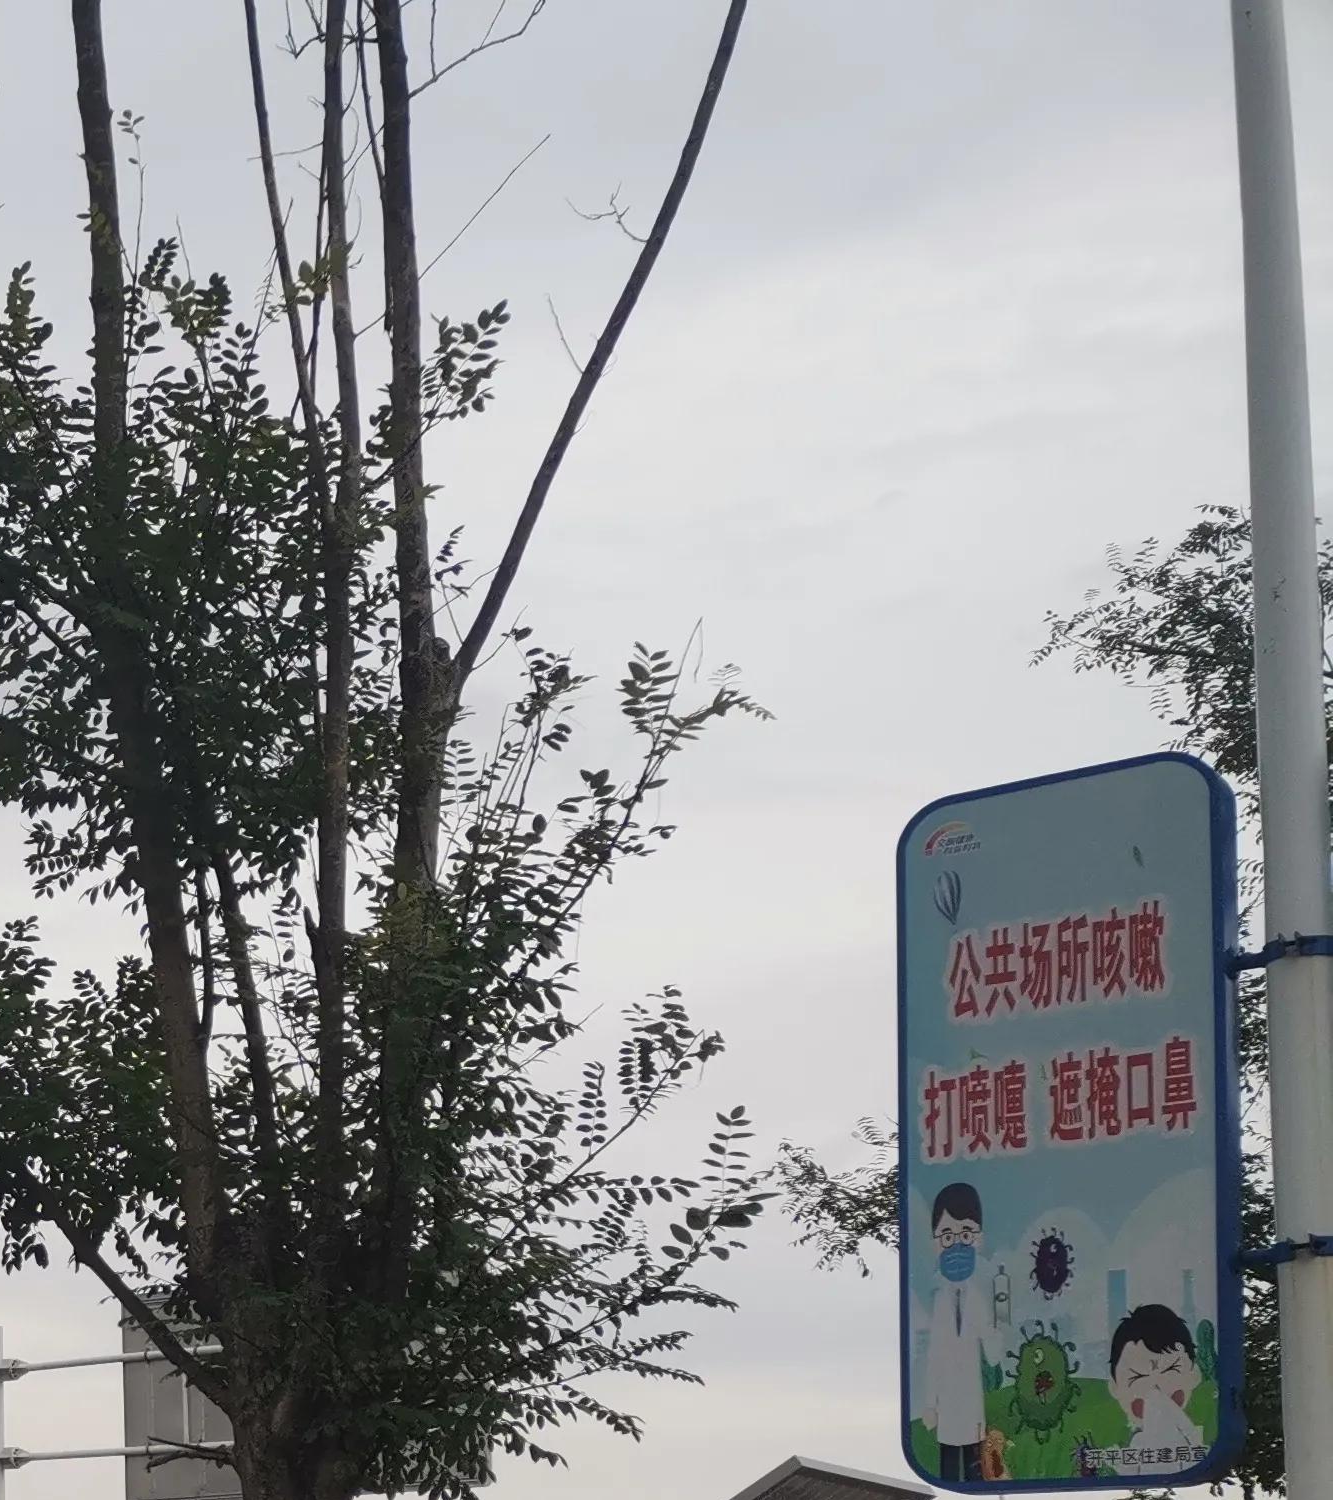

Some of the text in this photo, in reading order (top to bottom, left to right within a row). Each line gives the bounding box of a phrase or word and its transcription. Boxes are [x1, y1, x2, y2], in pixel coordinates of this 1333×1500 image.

[949, 899, 1166, 1018] 公共场所咳嗽
[924, 1035, 1198, 1159] 打喷嚏 遮掩口鼻
